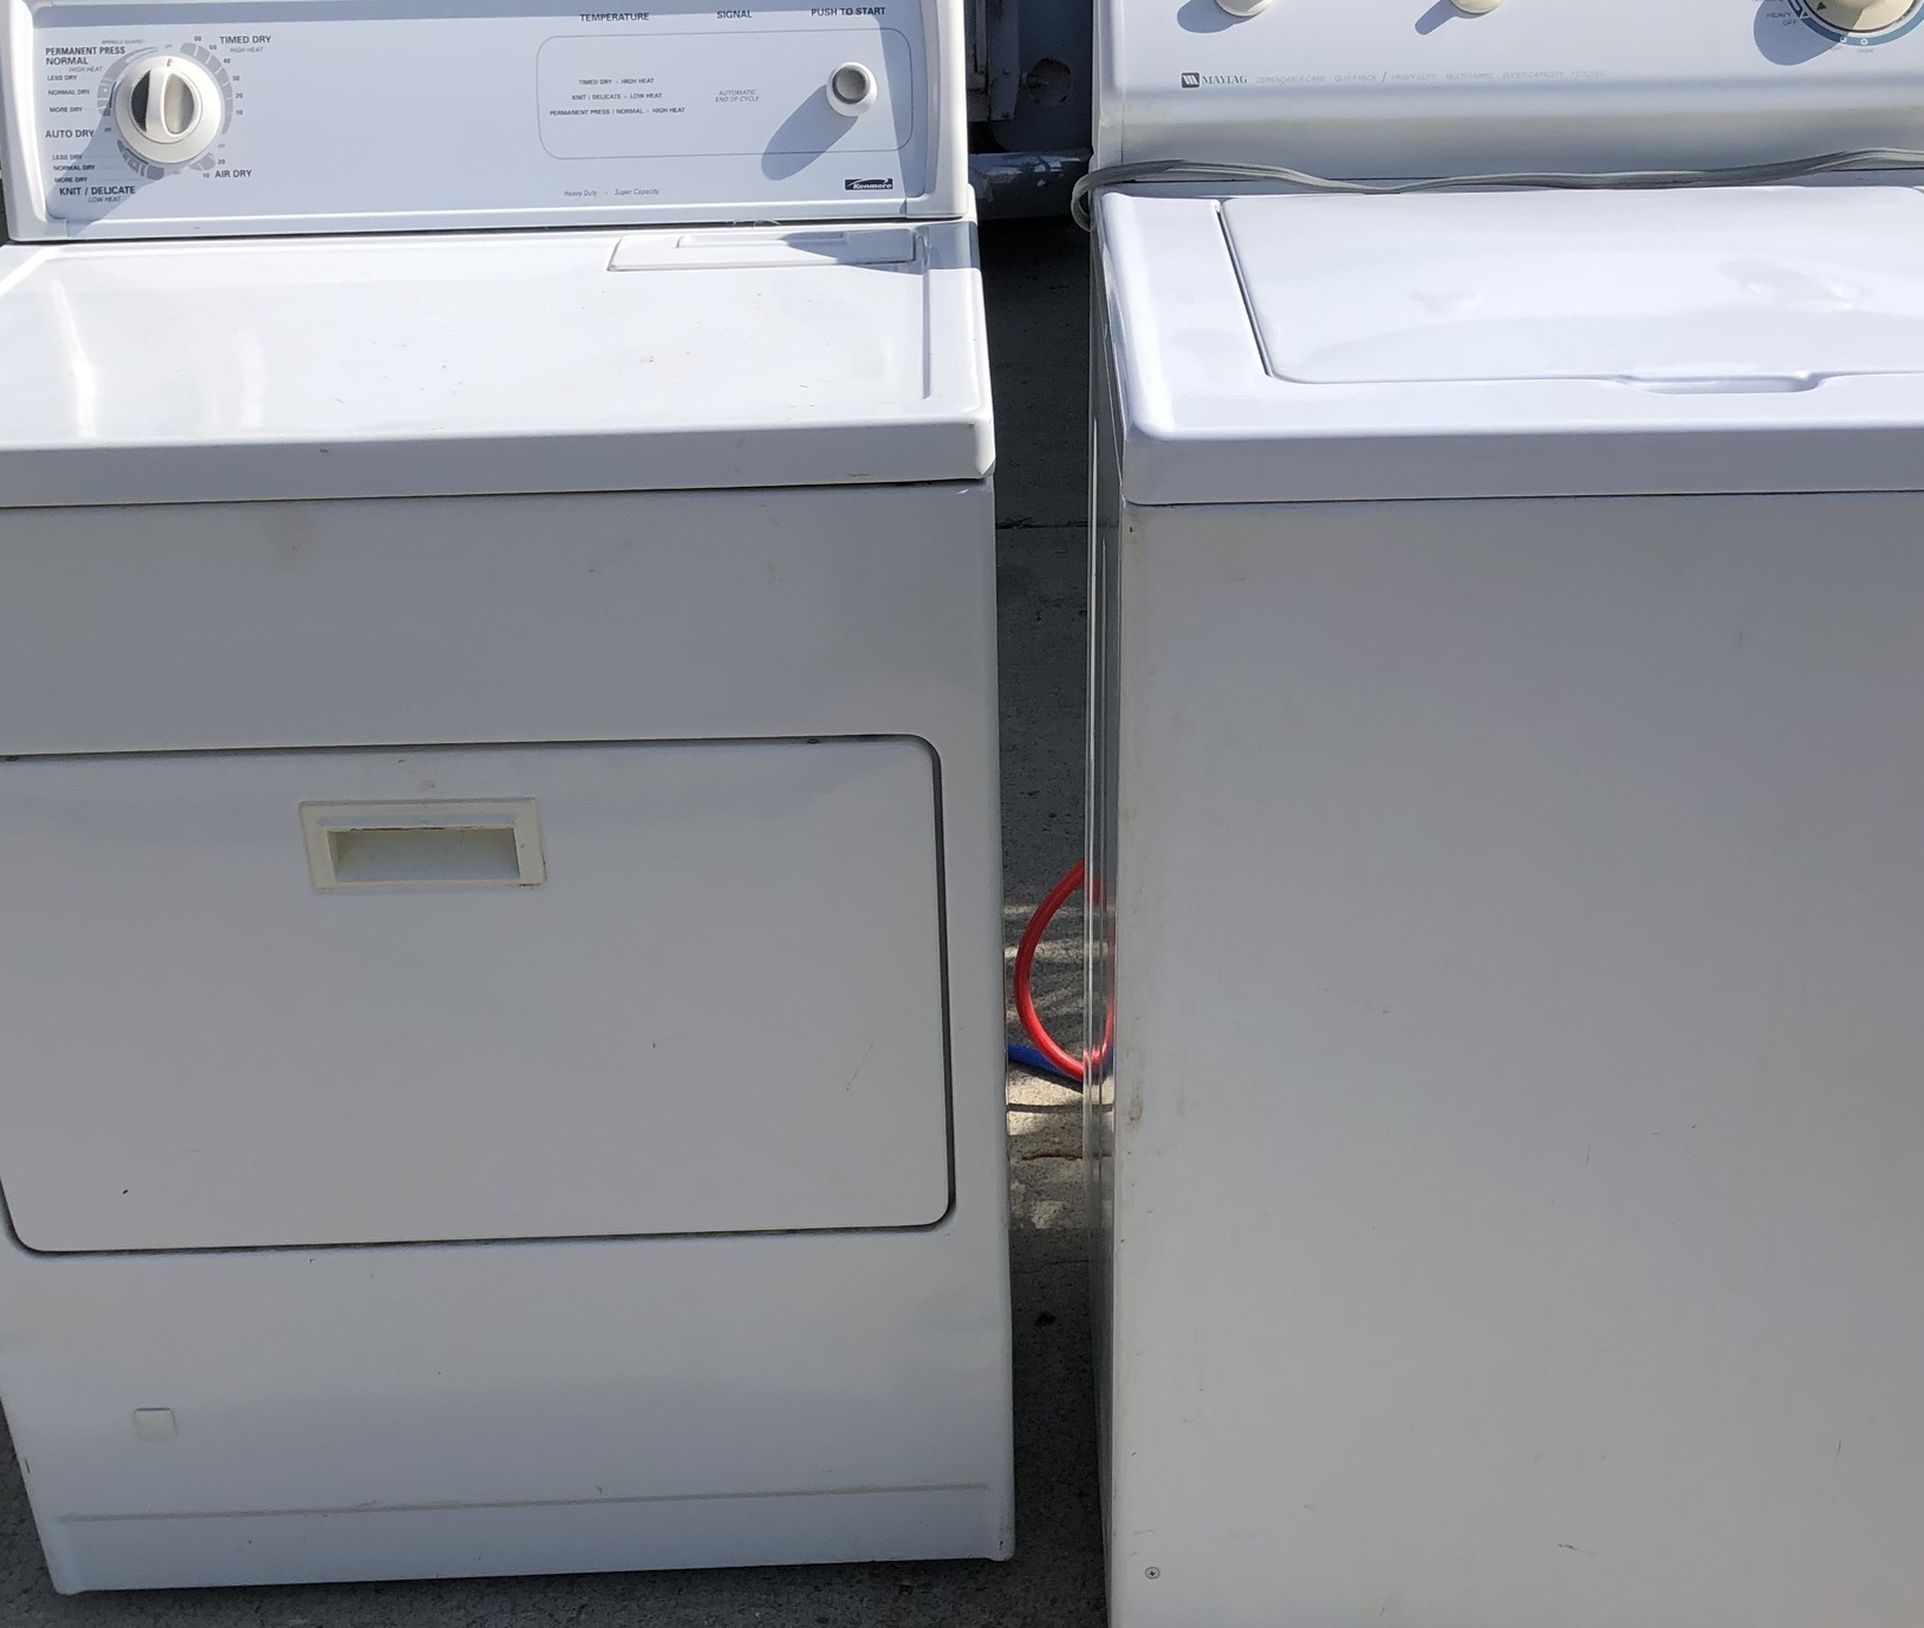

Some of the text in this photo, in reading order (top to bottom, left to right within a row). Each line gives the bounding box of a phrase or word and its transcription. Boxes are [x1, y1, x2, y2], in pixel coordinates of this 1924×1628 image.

[717, 10, 753, 19] SIGNAL
[811, 7, 886, 17] PUSH TO START
[580, 12, 650, 22] TEMPERATURE
[219, 35, 272, 44] TIMED DRY
[45, 46, 126, 55] PERMANENT PRESS
[46, 56, 89, 65] NORMAL
[1201, 74, 1248, 84] MAYTAG
[45, 129, 95, 138] AUTO DRY
[214, 169, 253, 178] AIR DRY
[59, 187, 82, 195] KNIT
[91, 185, 136, 195] DELICATE
[633, 188, 660, 196] Capacity
